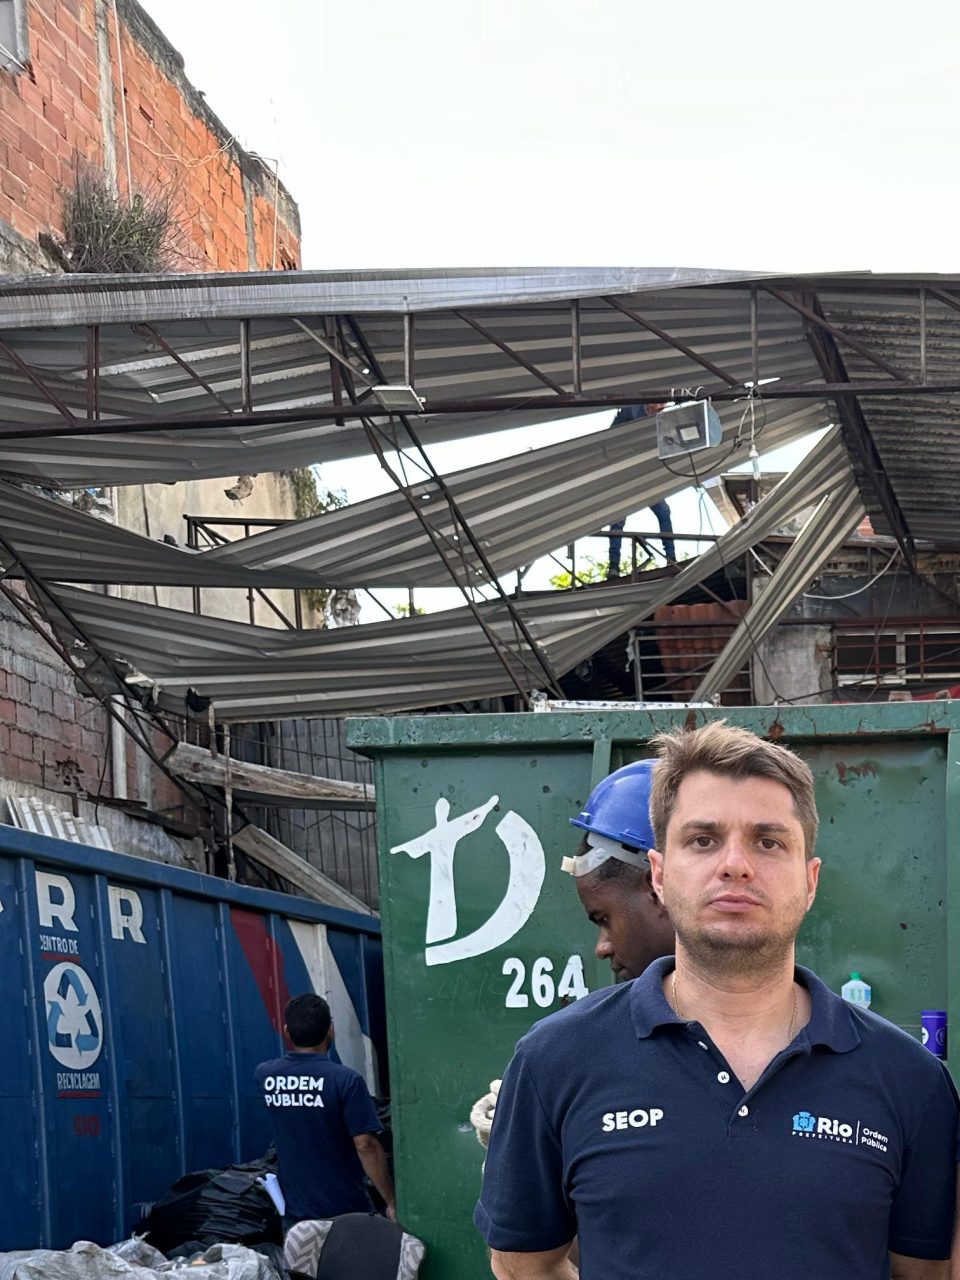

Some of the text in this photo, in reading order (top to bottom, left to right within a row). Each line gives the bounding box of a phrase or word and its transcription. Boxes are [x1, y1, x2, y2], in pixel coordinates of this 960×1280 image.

[69, 939, 79, 955] DE
[502, 954, 589, 1008] 264
[264, 1075, 324, 1091] ORDEM
[264, 1091, 325, 1108] PÚBLICA
[601, 1108, 664, 1132] SEOP
[817, 1117, 853, 1137] Rio
[792, 1131, 853, 1144] PREFEITURA
[862, 1127, 889, 1143] Ordem
